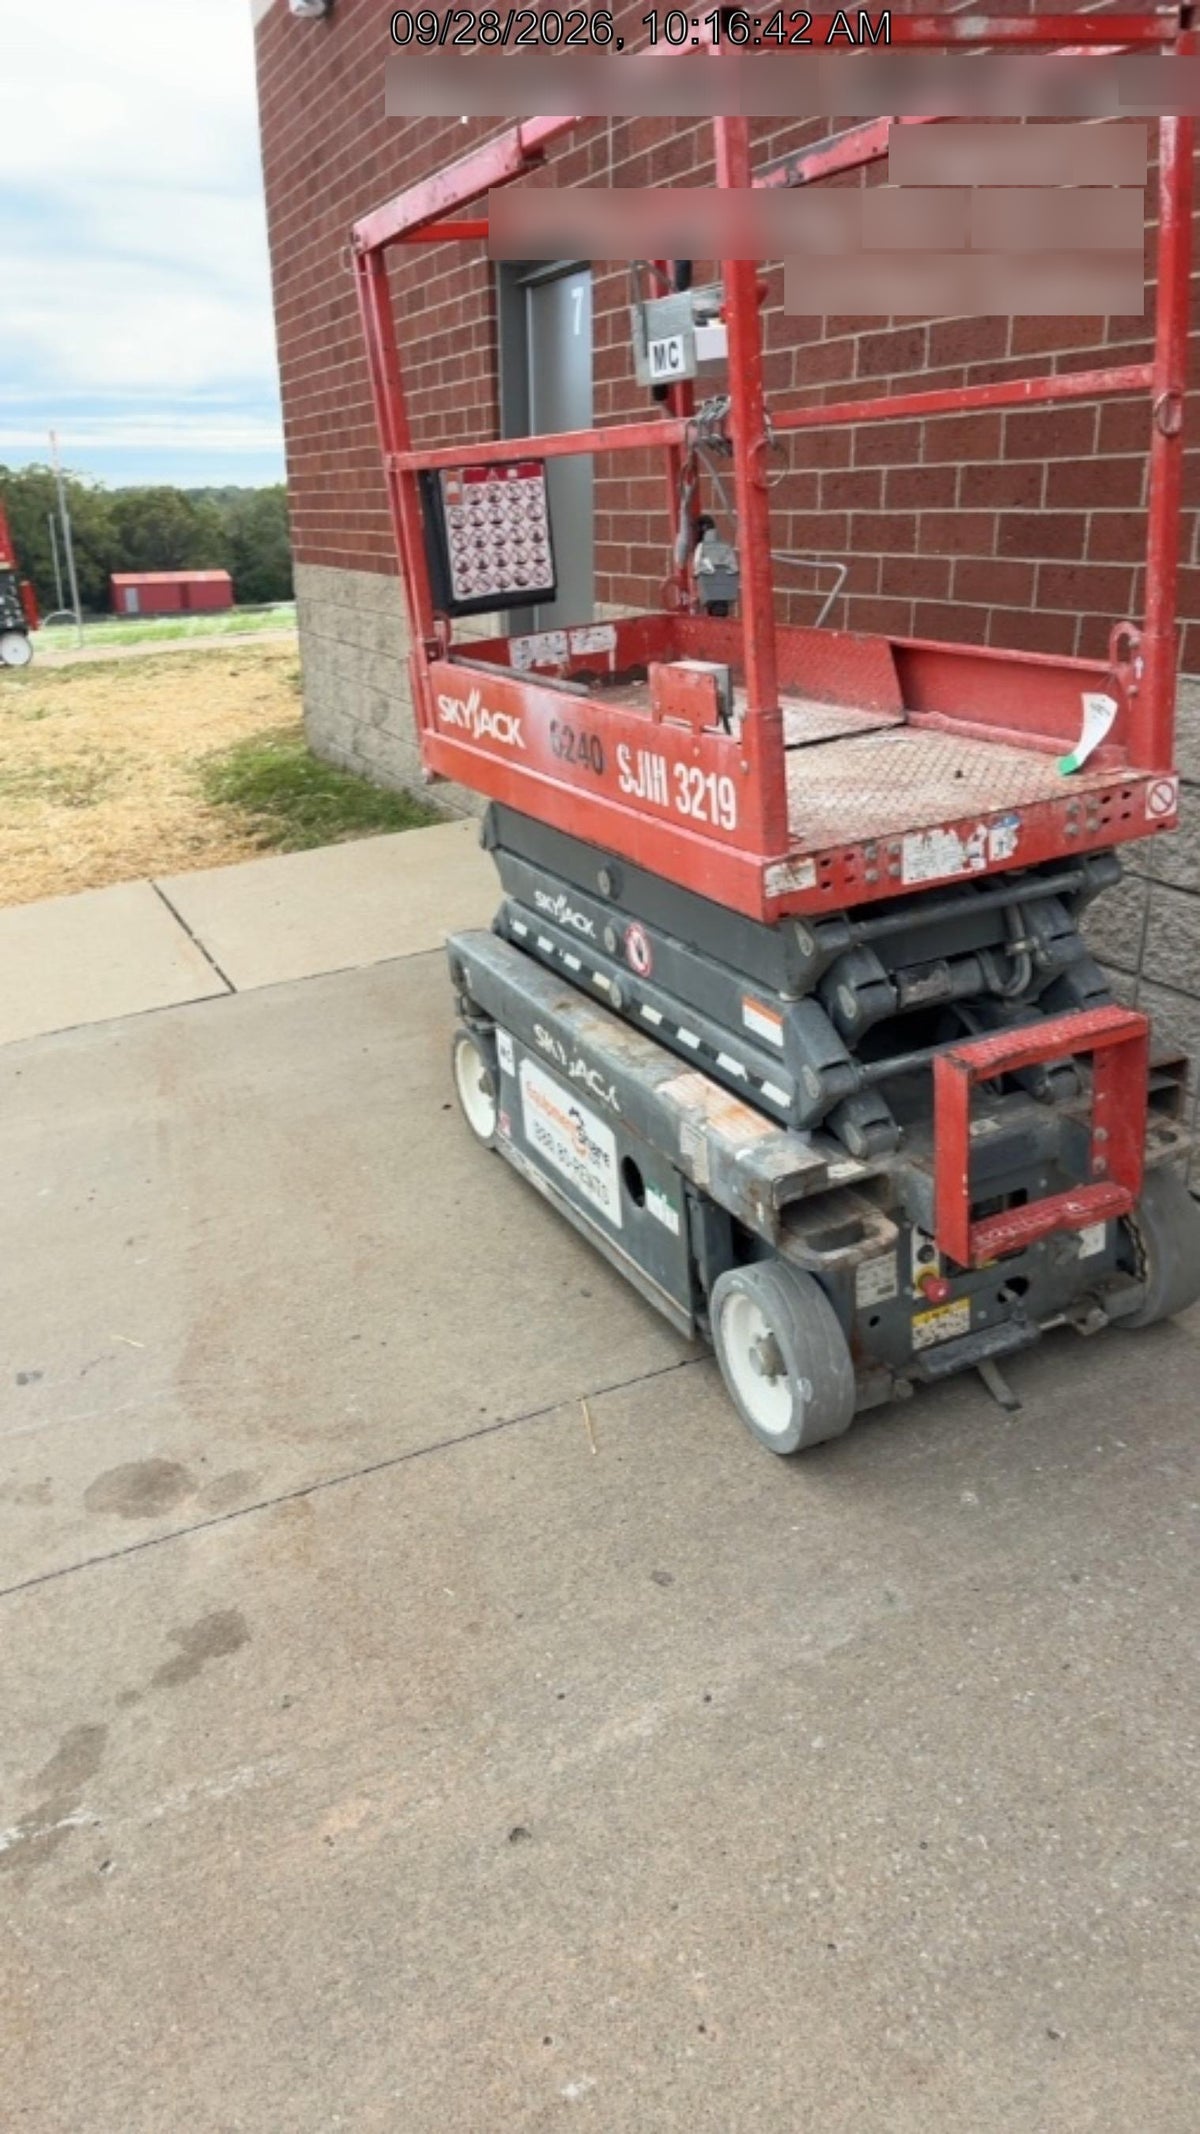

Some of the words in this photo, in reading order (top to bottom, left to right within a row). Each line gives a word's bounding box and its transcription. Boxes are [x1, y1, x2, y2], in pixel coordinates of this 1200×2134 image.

[653, 341, 680, 370] MC
[437, 687, 527, 750] SKYJACK
[672, 762, 738, 832] 3219
